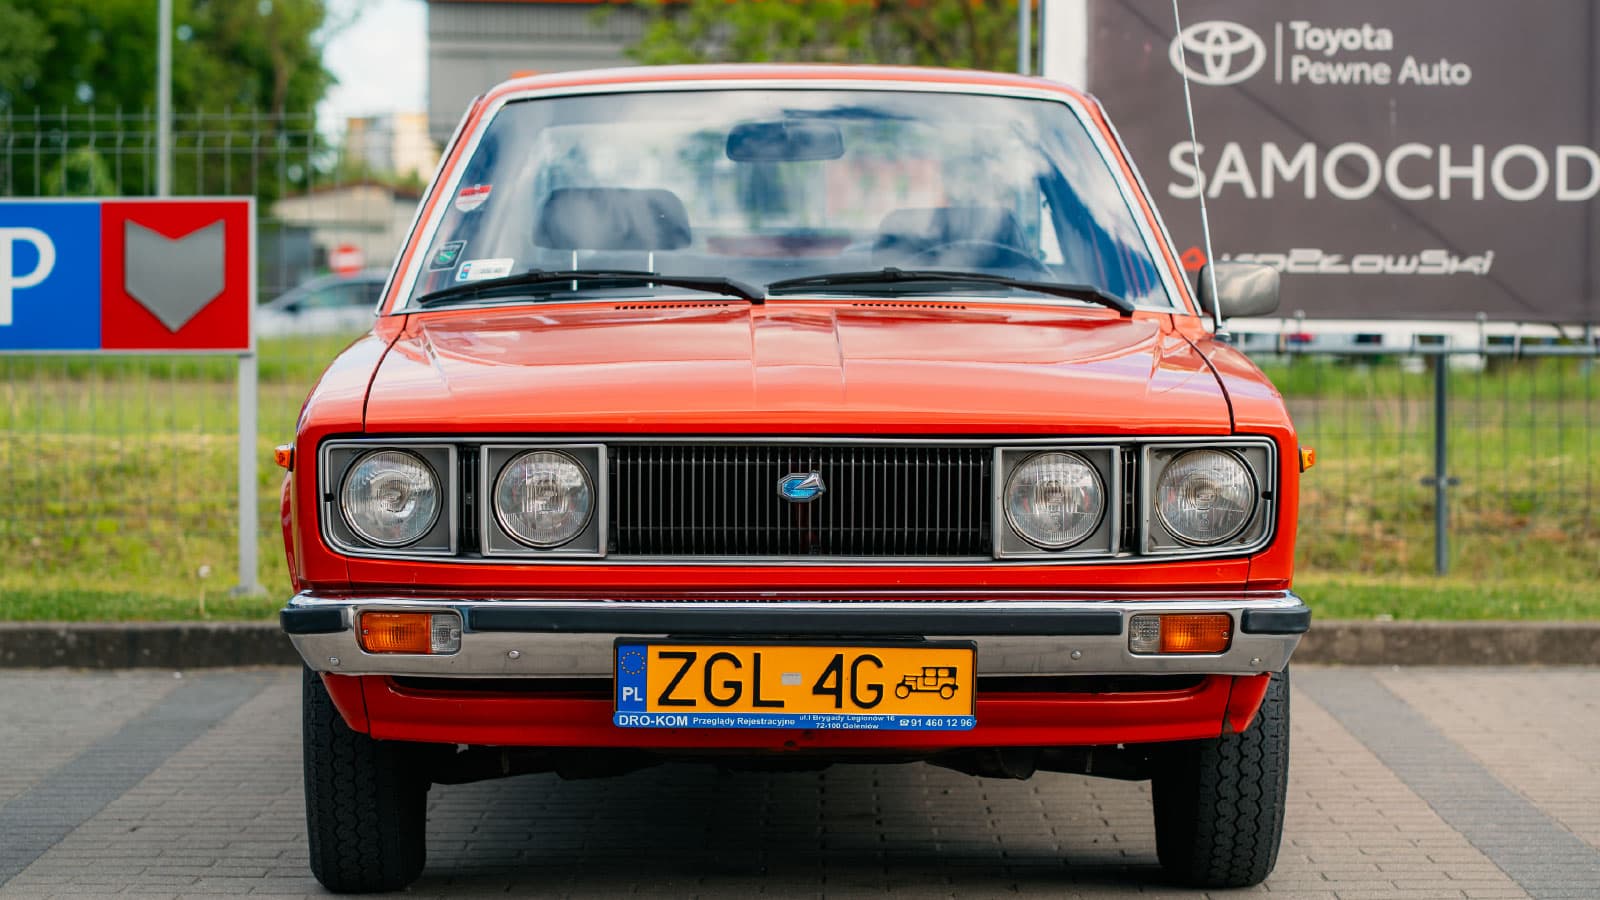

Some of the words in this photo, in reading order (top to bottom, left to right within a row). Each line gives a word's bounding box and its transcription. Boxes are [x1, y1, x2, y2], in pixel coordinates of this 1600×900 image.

[1290, 21, 1393, 55] Toyota
[1290, 56, 1391, 84] Pewne
[1399, 56, 1472, 85] Auto
[1168, 141, 1600, 201] SAMOCHOD
[658, 652, 784, 707] ZGL
[812, 653, 884, 709] 4G
[622, 687, 643, 702] PL
[619, 715, 688, 726] DRO-KOM
[692, 717, 735, 726] Przeglądy
[812, 715, 845, 723] Brygady
[911, 719, 922, 727] 91
[925, 719, 943, 727] 460
[946, 719, 957, 727] 12
[960, 719, 972, 727] 96
